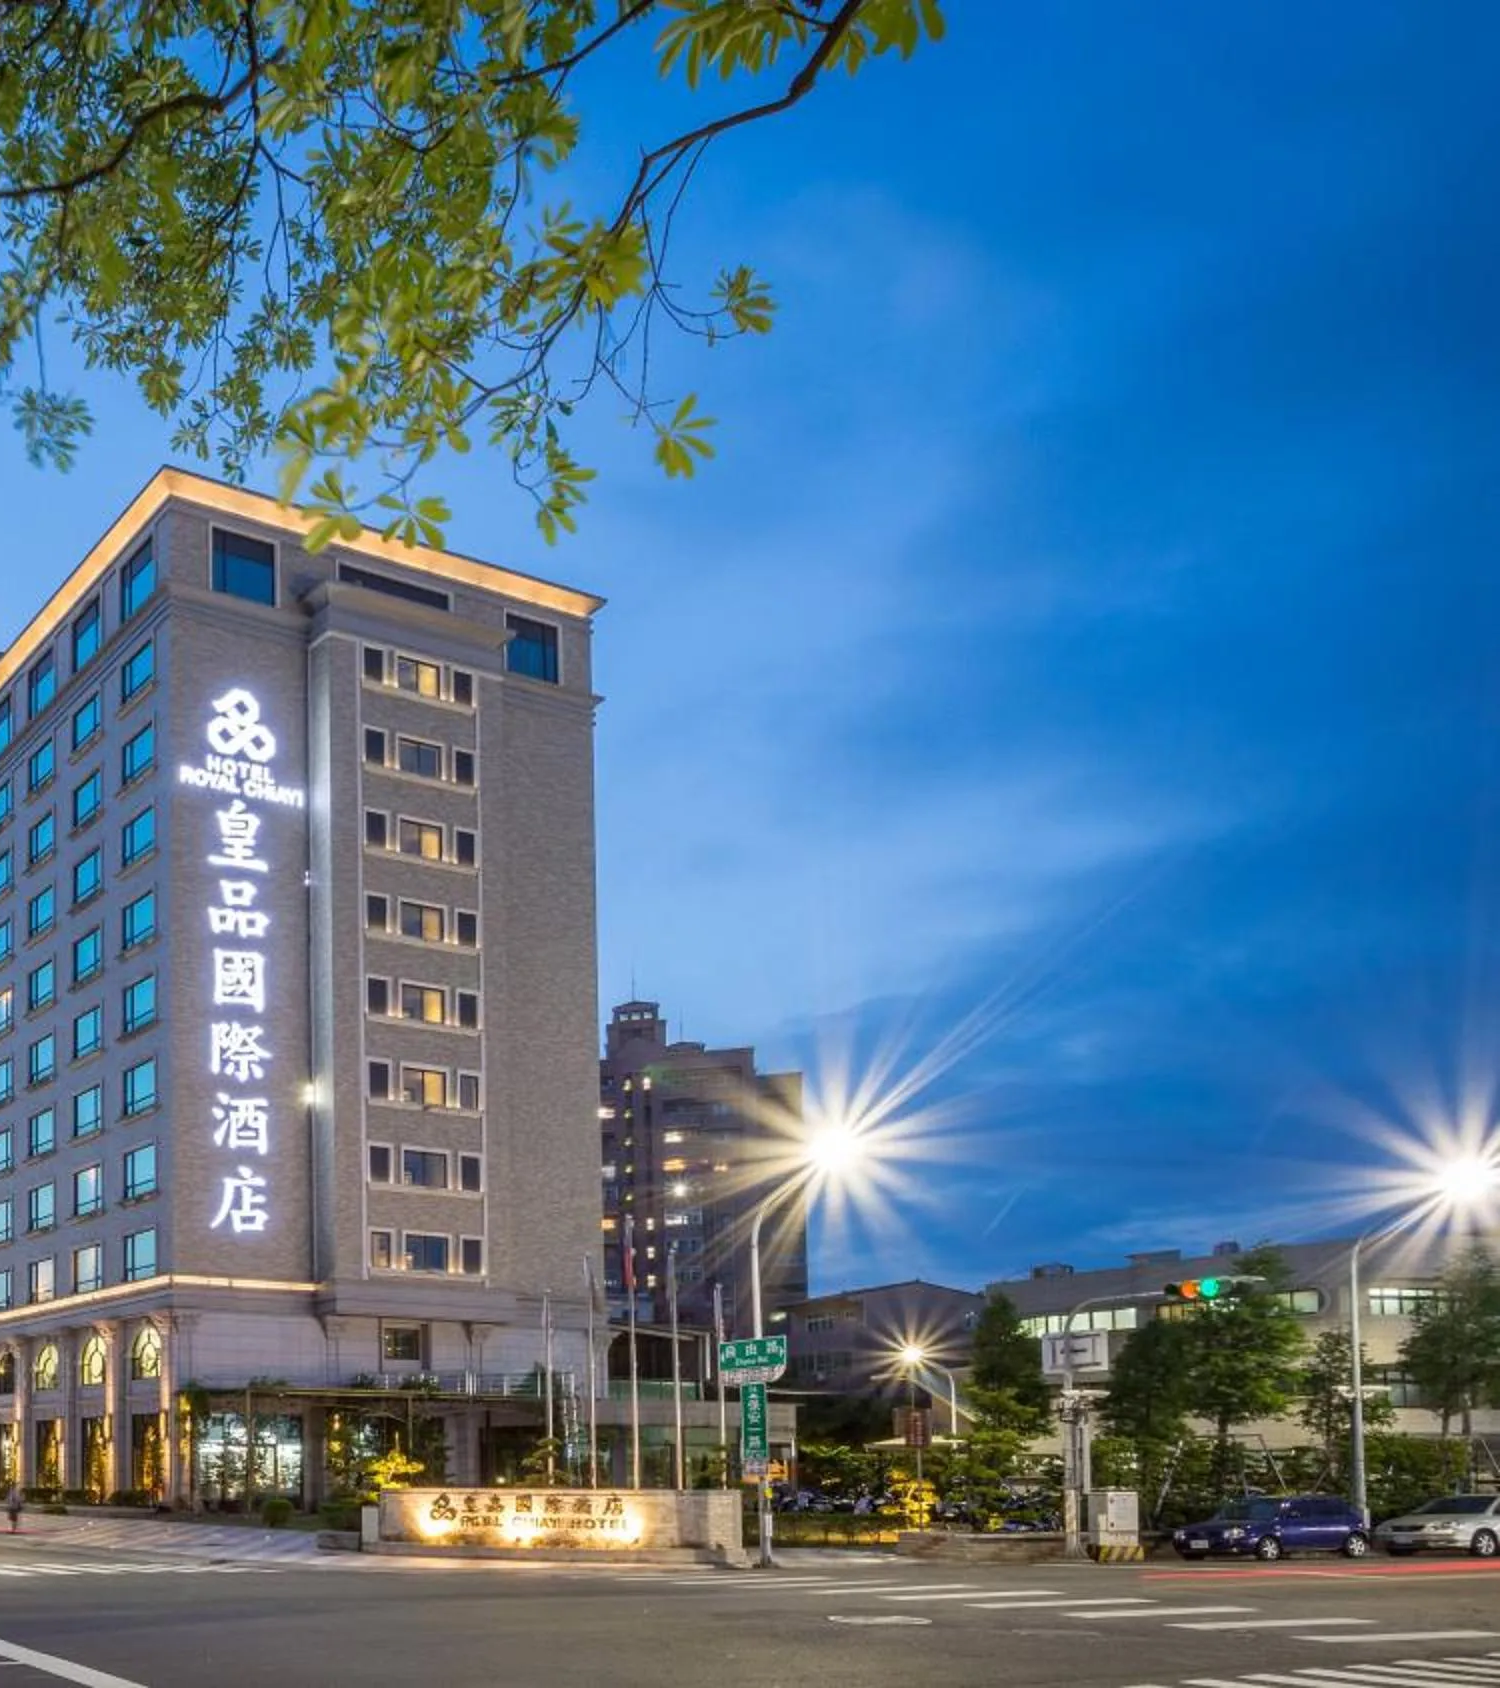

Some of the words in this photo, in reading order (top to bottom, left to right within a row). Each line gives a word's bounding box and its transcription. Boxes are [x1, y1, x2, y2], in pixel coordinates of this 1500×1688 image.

[179, 765, 241, 794] ROYAL
[243, 778, 304, 807] CHIAYI
[206, 754, 275, 785] HOTEL
[207, 800, 272, 1233] 皇品國際酒店
